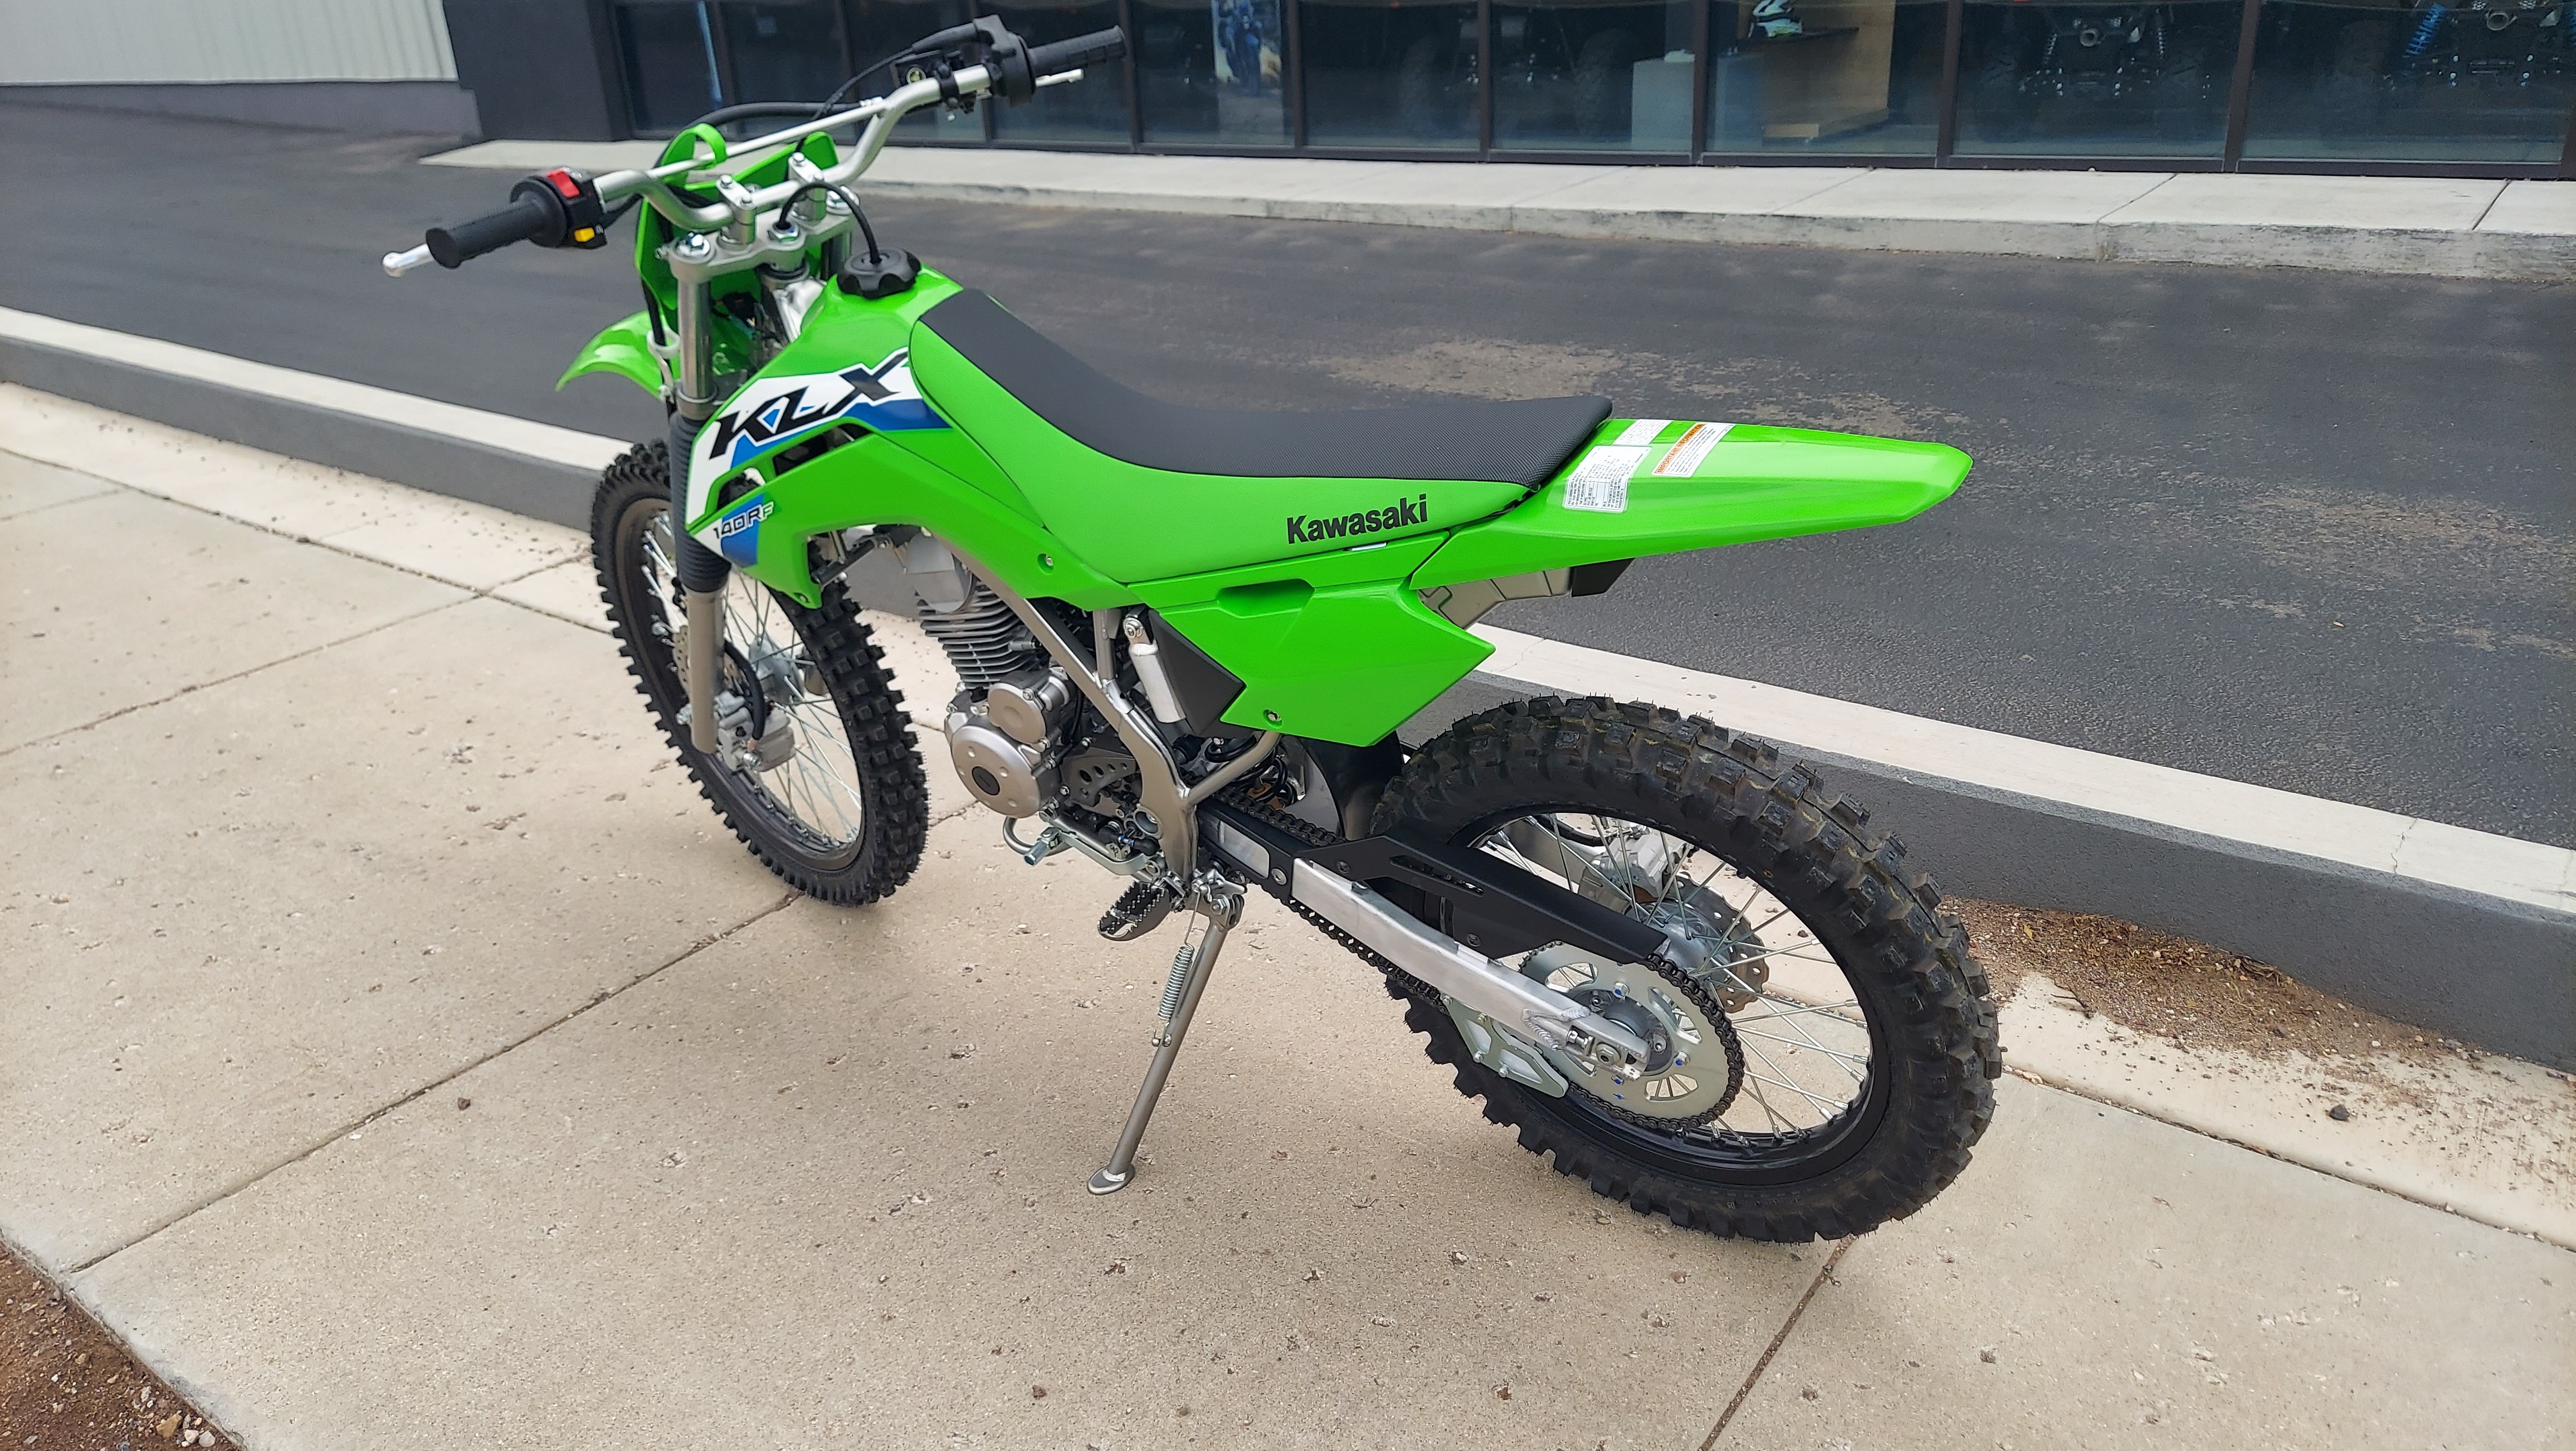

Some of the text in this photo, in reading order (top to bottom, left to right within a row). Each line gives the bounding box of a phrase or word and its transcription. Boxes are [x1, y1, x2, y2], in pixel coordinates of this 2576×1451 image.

[709, 351, 909, 460] KLX
[1656, 447, 1680, 473] IMPORTANT
[713, 502, 774, 539] 140RF
[1286, 493, 1428, 544] Kawasaki
